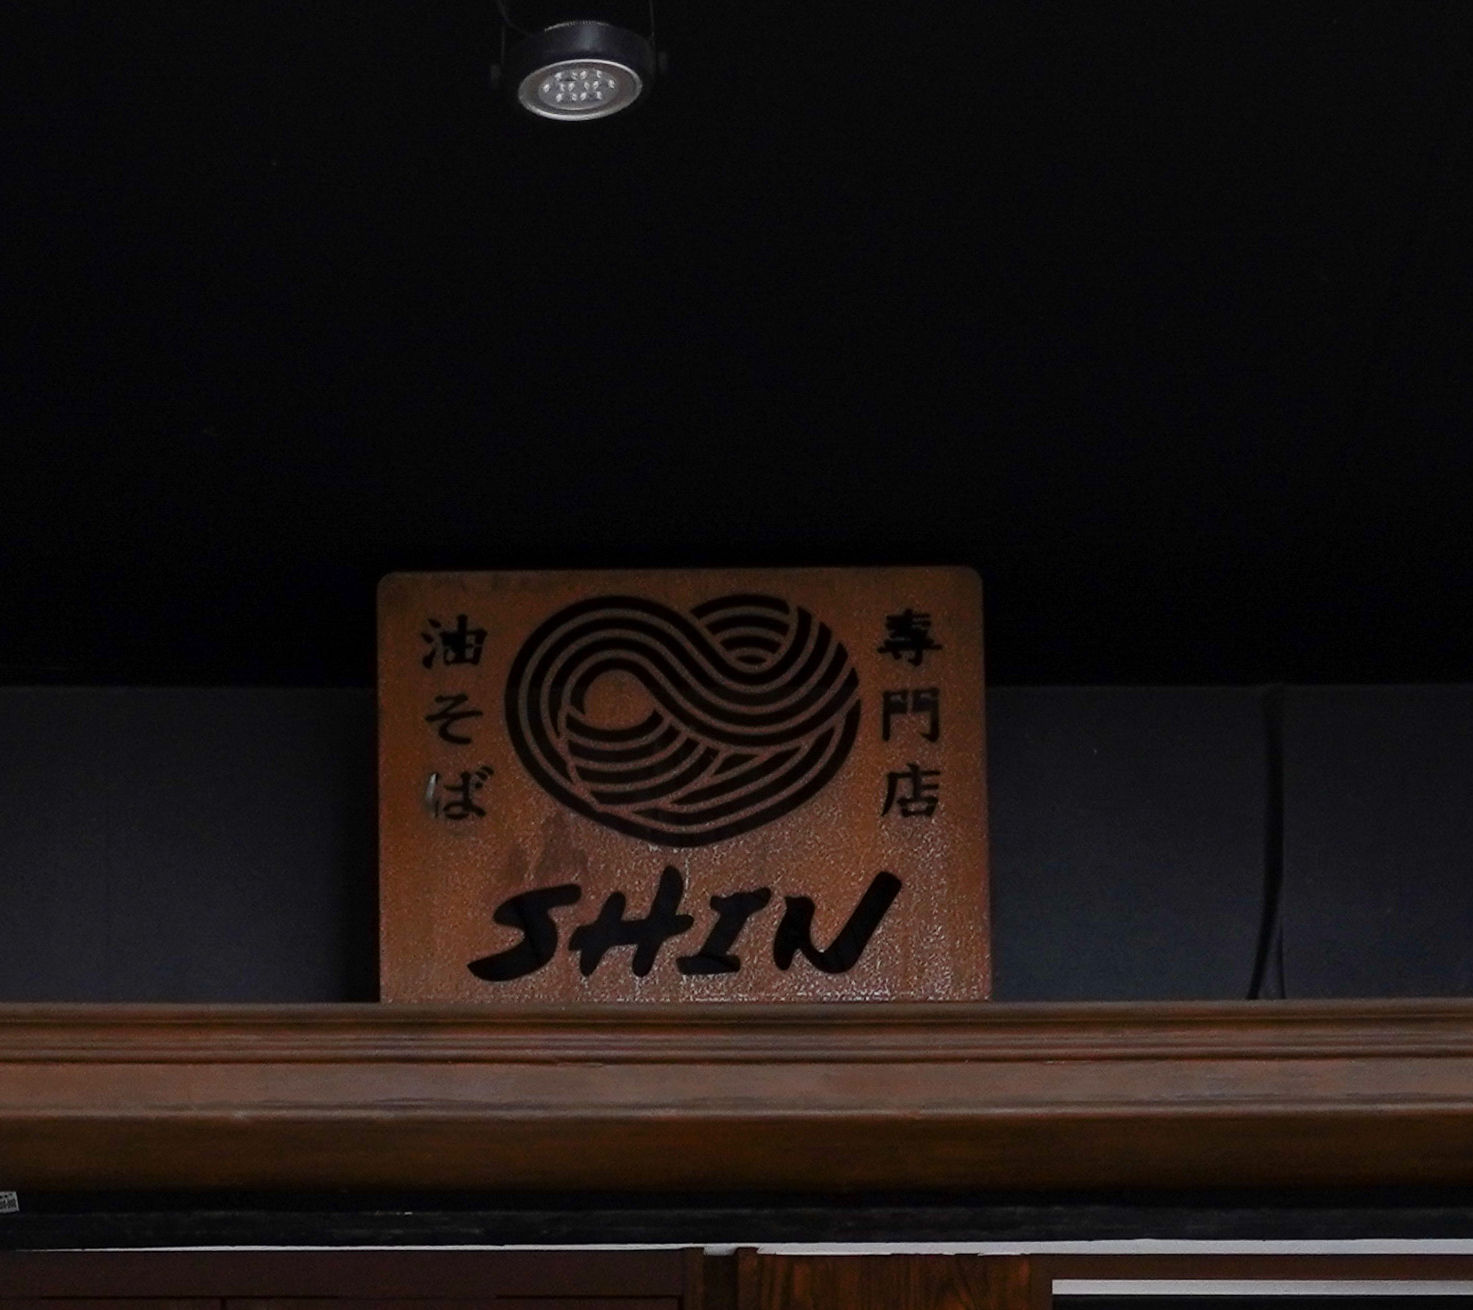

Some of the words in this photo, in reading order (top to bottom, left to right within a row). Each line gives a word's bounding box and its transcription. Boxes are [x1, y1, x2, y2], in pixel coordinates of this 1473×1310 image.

[420, 613, 495, 820] 油そば
[466, 864, 903, 983] SHIN
